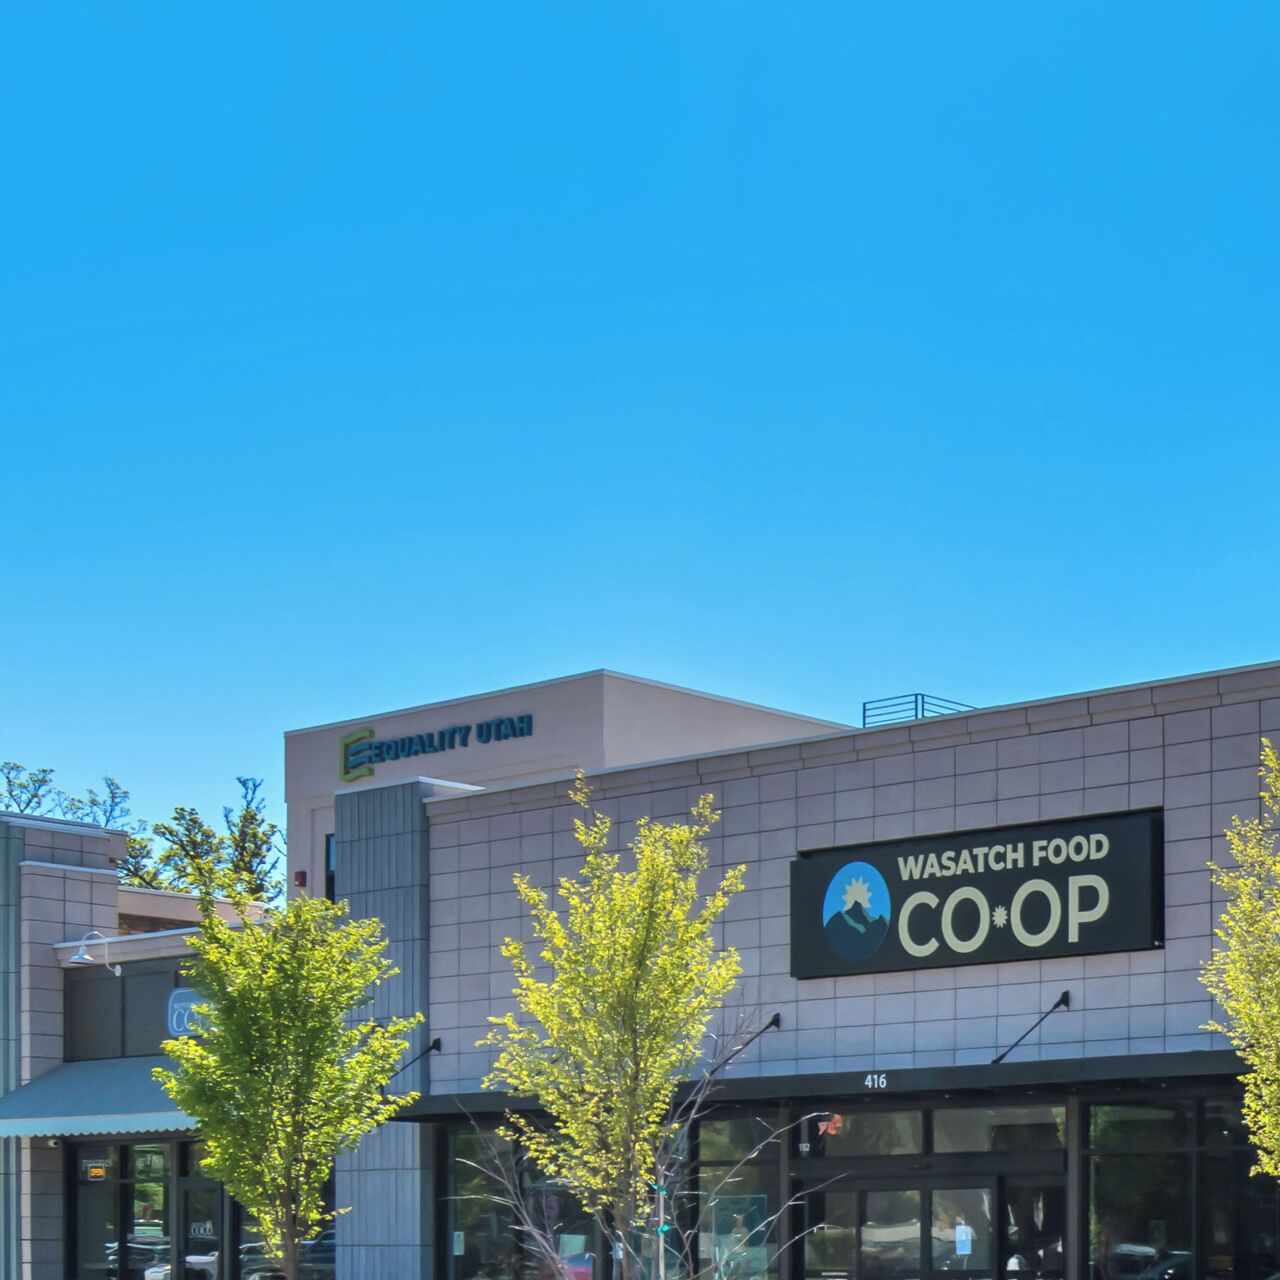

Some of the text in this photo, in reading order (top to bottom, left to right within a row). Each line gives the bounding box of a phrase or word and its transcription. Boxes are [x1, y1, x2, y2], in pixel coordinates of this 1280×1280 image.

[368, 725, 473, 764] EQUALITY
[475, 714, 534, 745] UTAH
[897, 832, 1110, 881] WASATCH FOOD
[864, 1073, 887, 1089] 416
